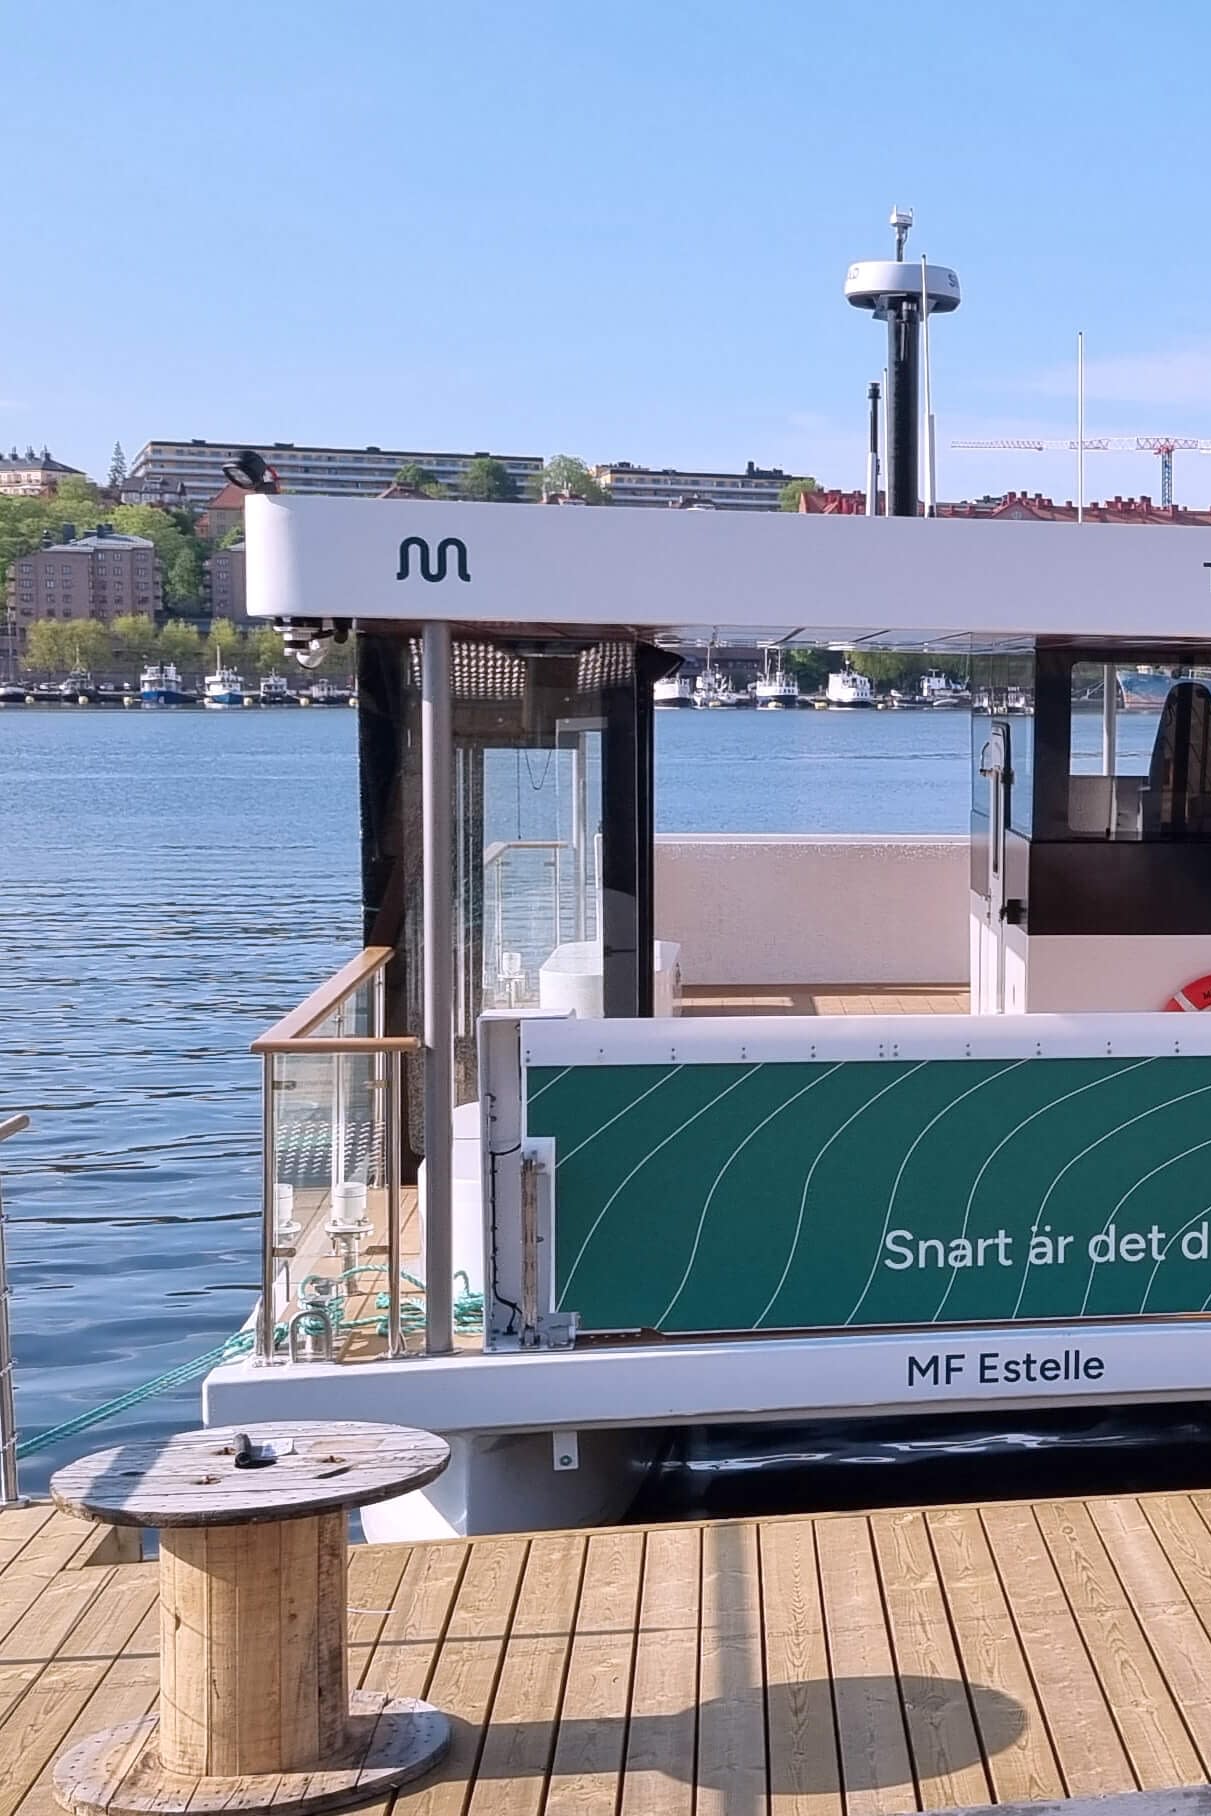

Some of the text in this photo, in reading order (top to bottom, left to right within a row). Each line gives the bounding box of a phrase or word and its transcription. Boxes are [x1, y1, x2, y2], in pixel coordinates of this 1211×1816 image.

[884, 1229, 1013, 1270] Snart
[1029, 1225, 1074, 1265] är
[1088, 1224, 1166, 1263] det
[908, 1349, 1105, 1387] MF Estelle
